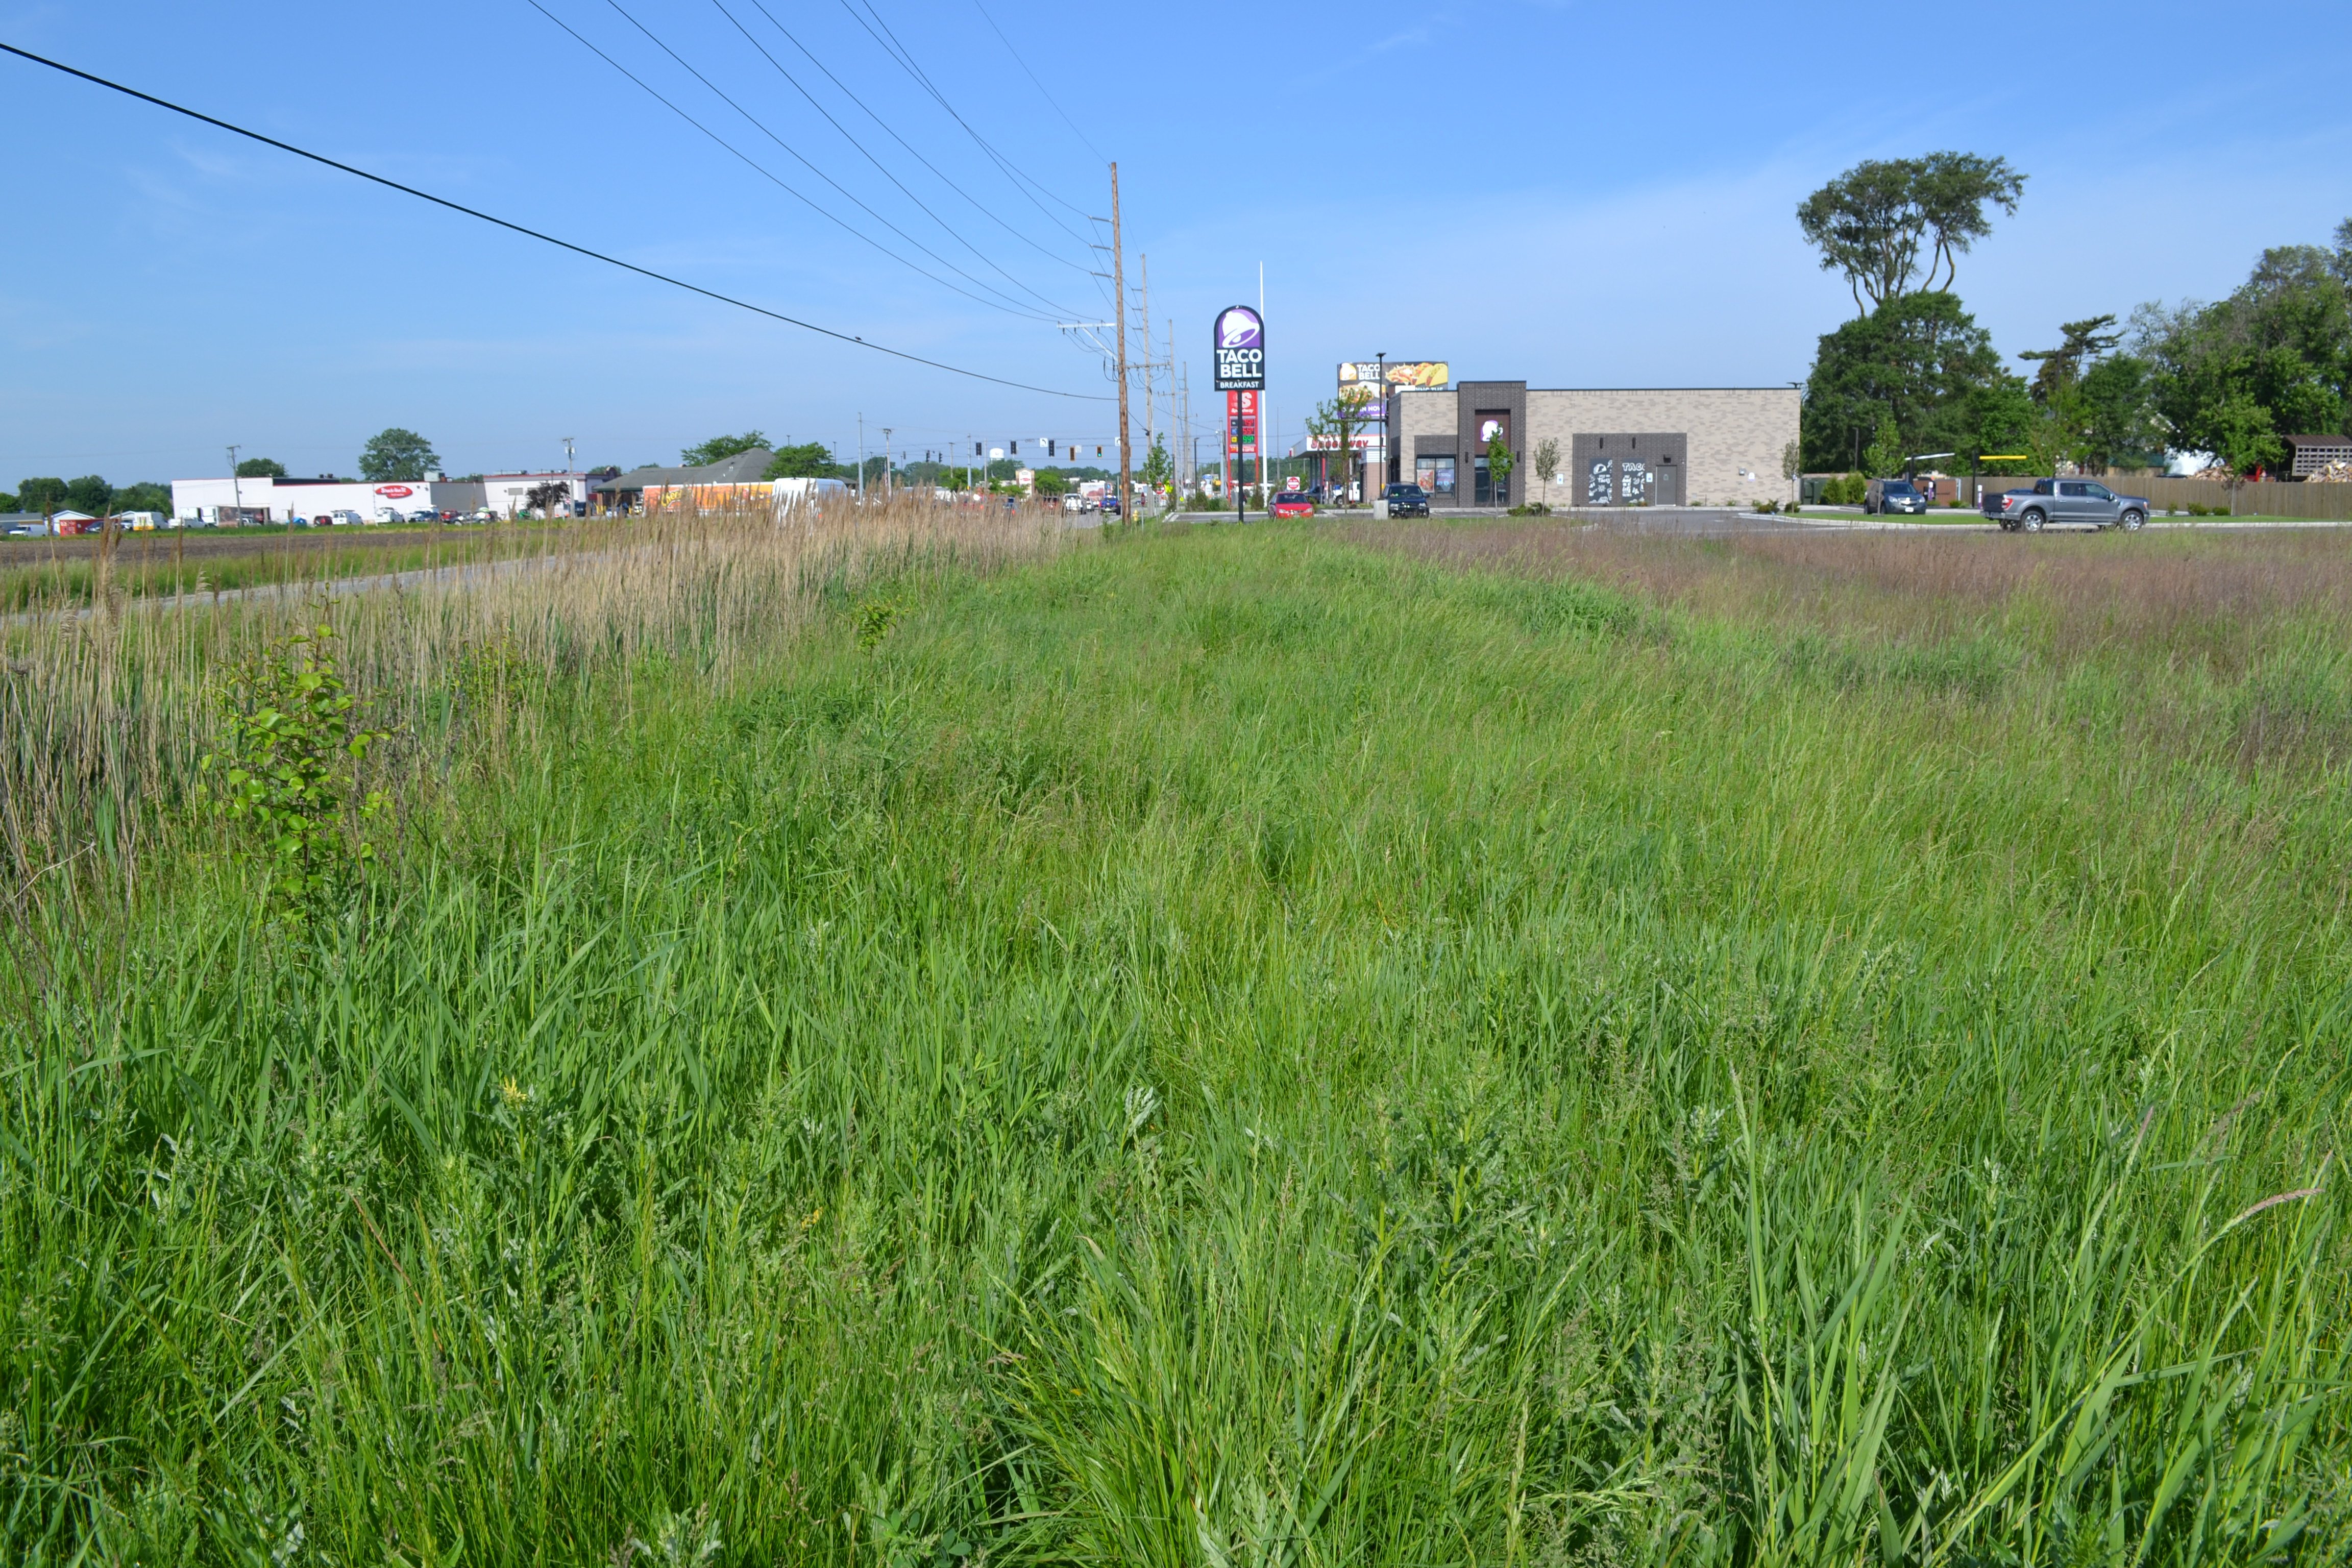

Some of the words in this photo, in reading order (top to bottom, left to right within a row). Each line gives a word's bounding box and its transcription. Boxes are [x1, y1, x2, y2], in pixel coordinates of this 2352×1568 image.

[1216, 349, 1262, 363] TACO
[1220, 363, 1262, 378] BELL
[1357, 364, 1380, 372] TACO
[1359, 372, 1380, 380] BELL
